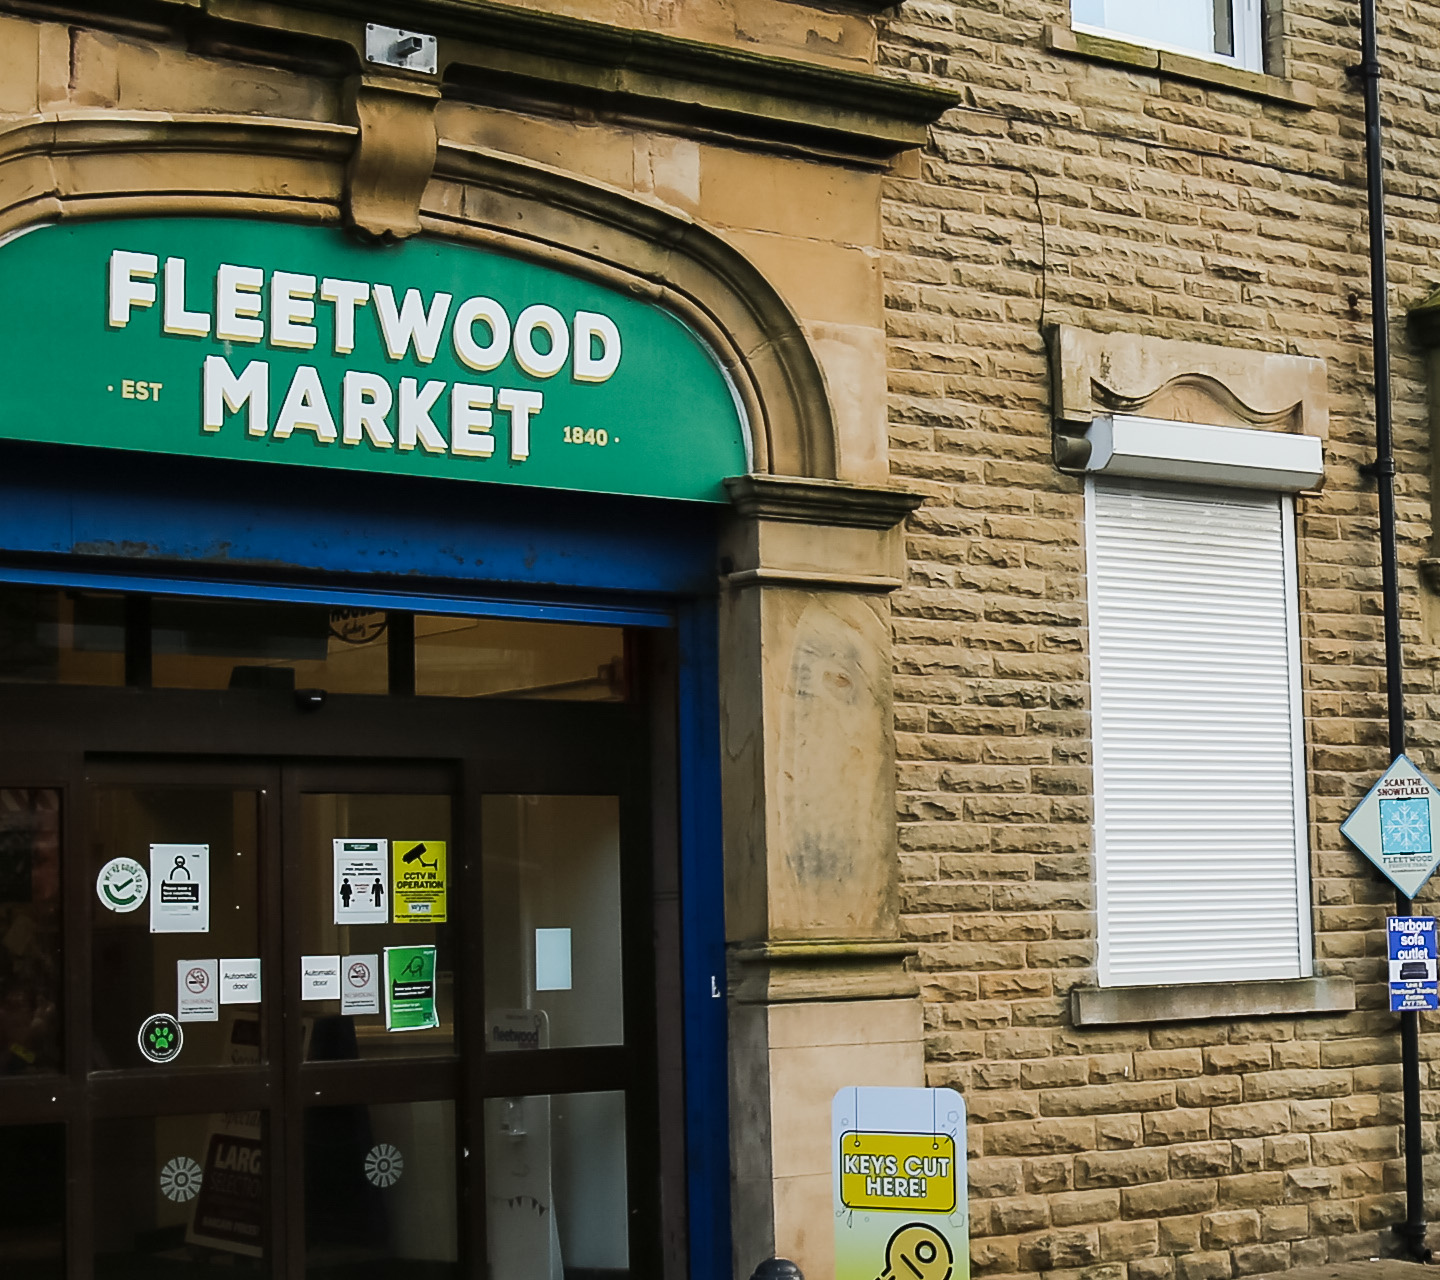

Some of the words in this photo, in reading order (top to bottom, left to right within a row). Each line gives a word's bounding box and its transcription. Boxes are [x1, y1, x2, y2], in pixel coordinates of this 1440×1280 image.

[109, 249, 621, 383] FLEETWOOD
[121, 378, 162, 402] EST
[203, 354, 543, 461] MARKET
[563, 425, 608, 447] 1840
[1384, 779, 1405, 787] SCAN
[1406, 778, 1422, 786] THE
[1377, 787, 1430, 796] SNOWFLAKES
[404, 872, 425, 880] CCTV
[427, 872, 436, 880] IN
[396, 881, 444, 889] OPERATION
[1389, 918, 1434, 932] Harbour
[1400, 933, 1425, 946] sofa
[1397, 947, 1428, 960] outlet
[224, 972, 257, 980] Automatic
[232, 982, 248, 990] door
[844, 1154, 898, 1175] KEYS
[904, 1155, 950, 1177] CUT
[866, 1176, 927, 1198] HERE!
